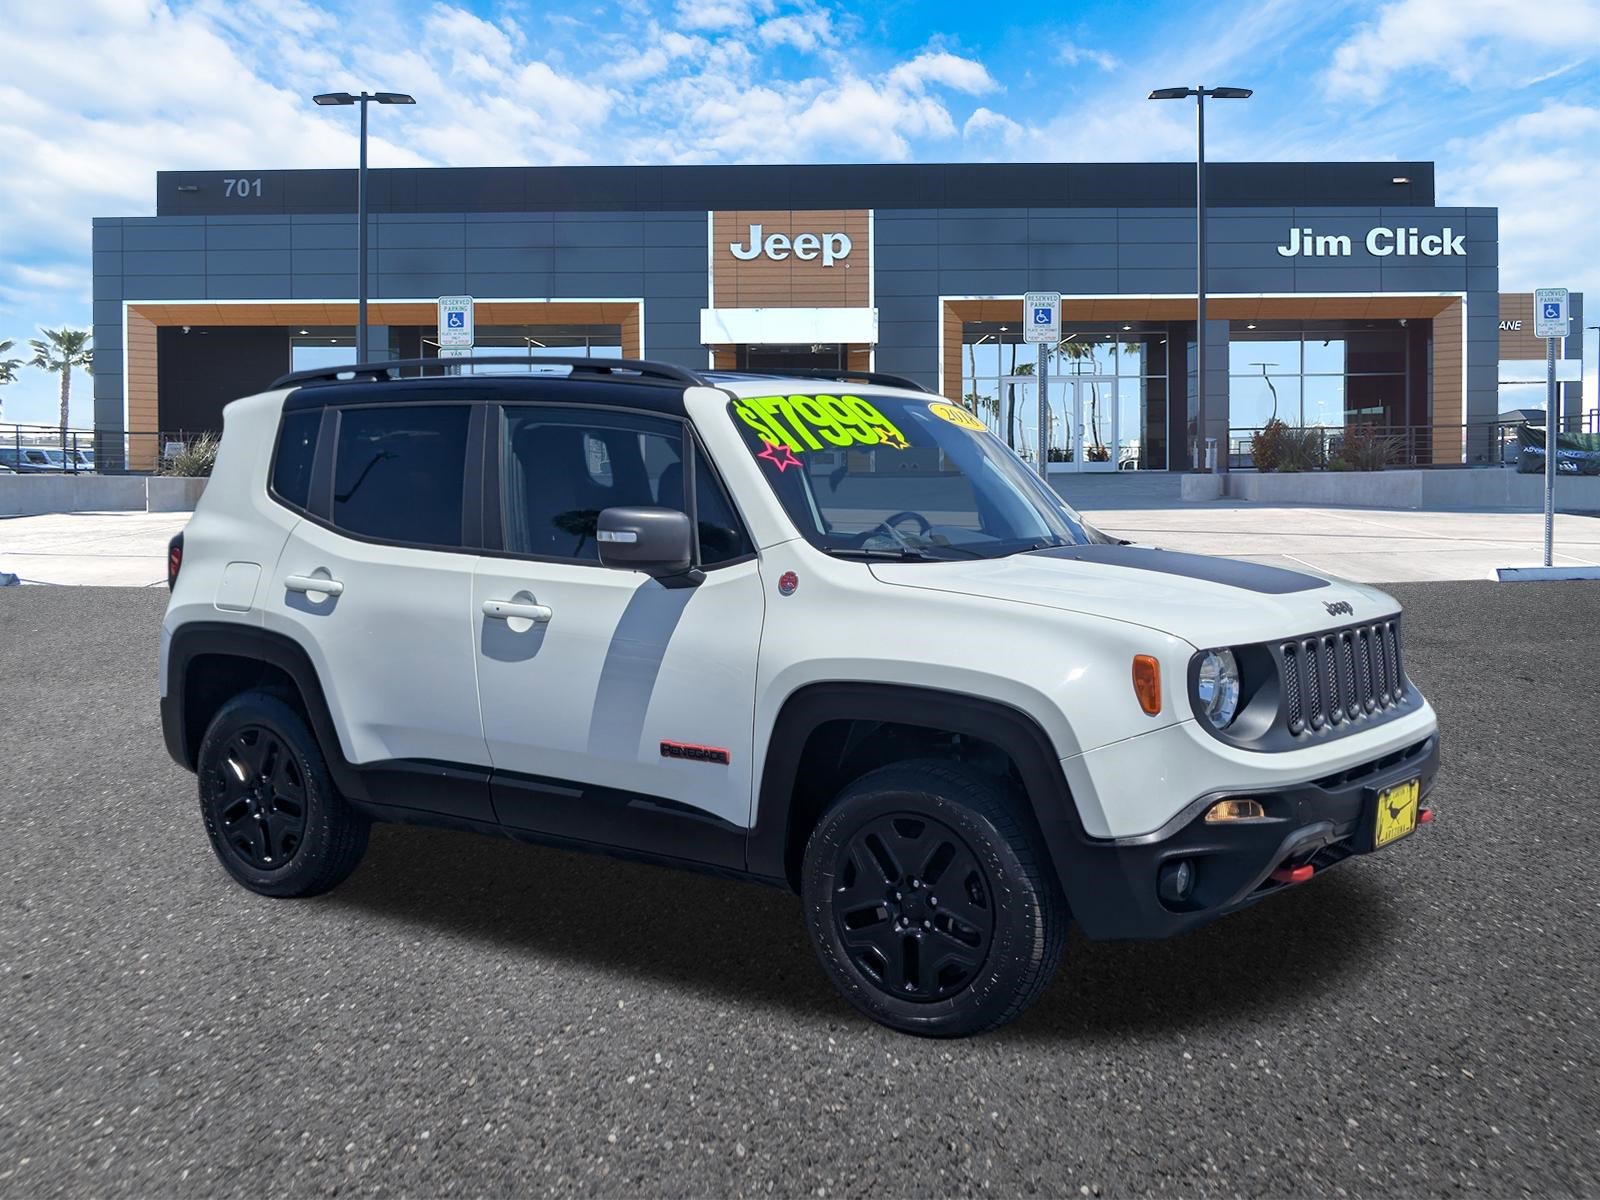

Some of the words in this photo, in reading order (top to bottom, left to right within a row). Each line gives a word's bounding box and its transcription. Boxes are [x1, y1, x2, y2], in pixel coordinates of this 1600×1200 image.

[223, 178, 262, 197] 701
[729, 224, 852, 267] Jeep
[1277, 228, 1351, 257] Jim
[1365, 227, 1467, 256] Click
[732, 394, 906, 453] $17999
[1320, 600, 1354, 617] Jeep
